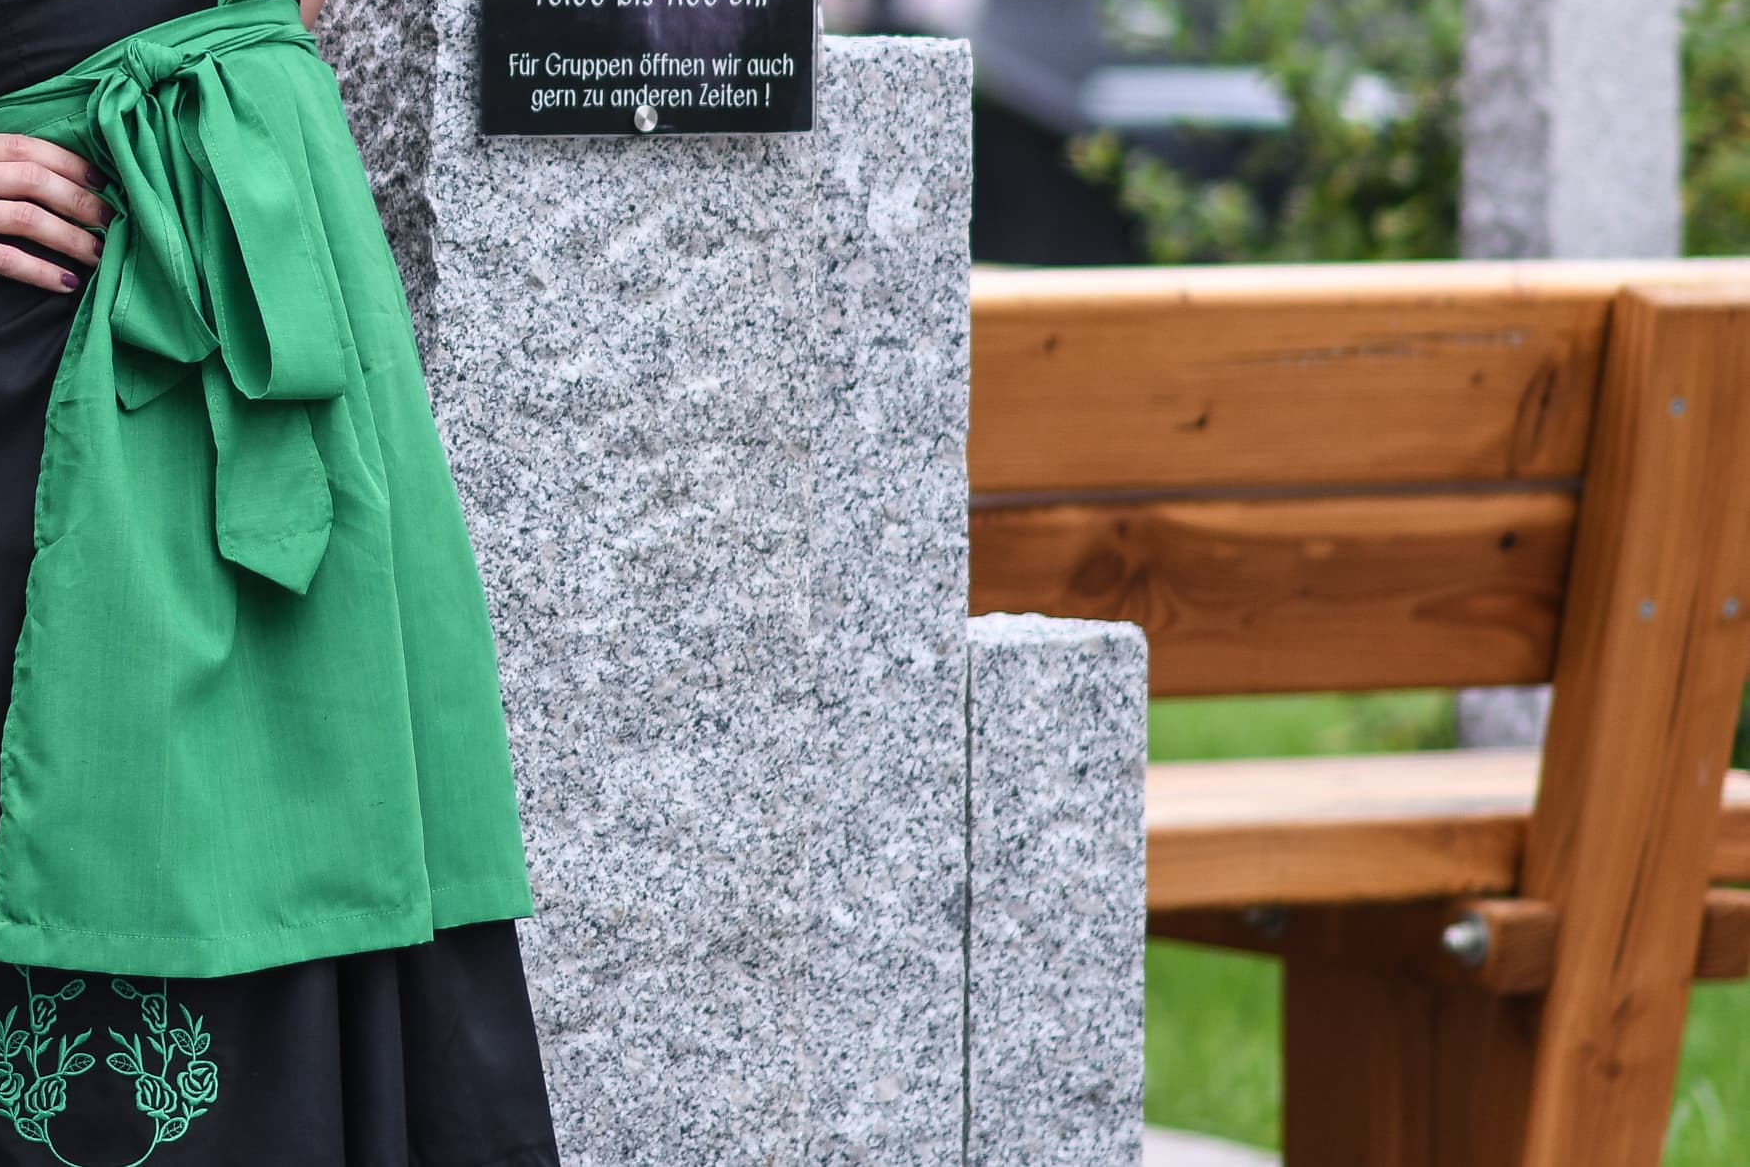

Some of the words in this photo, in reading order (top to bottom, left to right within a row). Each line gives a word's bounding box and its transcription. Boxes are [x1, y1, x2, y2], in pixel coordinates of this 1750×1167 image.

[509, 53, 540, 78] Für
[546, 53, 633, 79] Gruppen
[640, 54, 704, 76] öffnen
[712, 53, 741, 76] wir
[747, 53, 794, 76] auch
[531, 87, 576, 112] gern
[583, 88, 603, 107] zu
[611, 84, 692, 107] anderen
[699, 84, 758, 107] Zeiten
